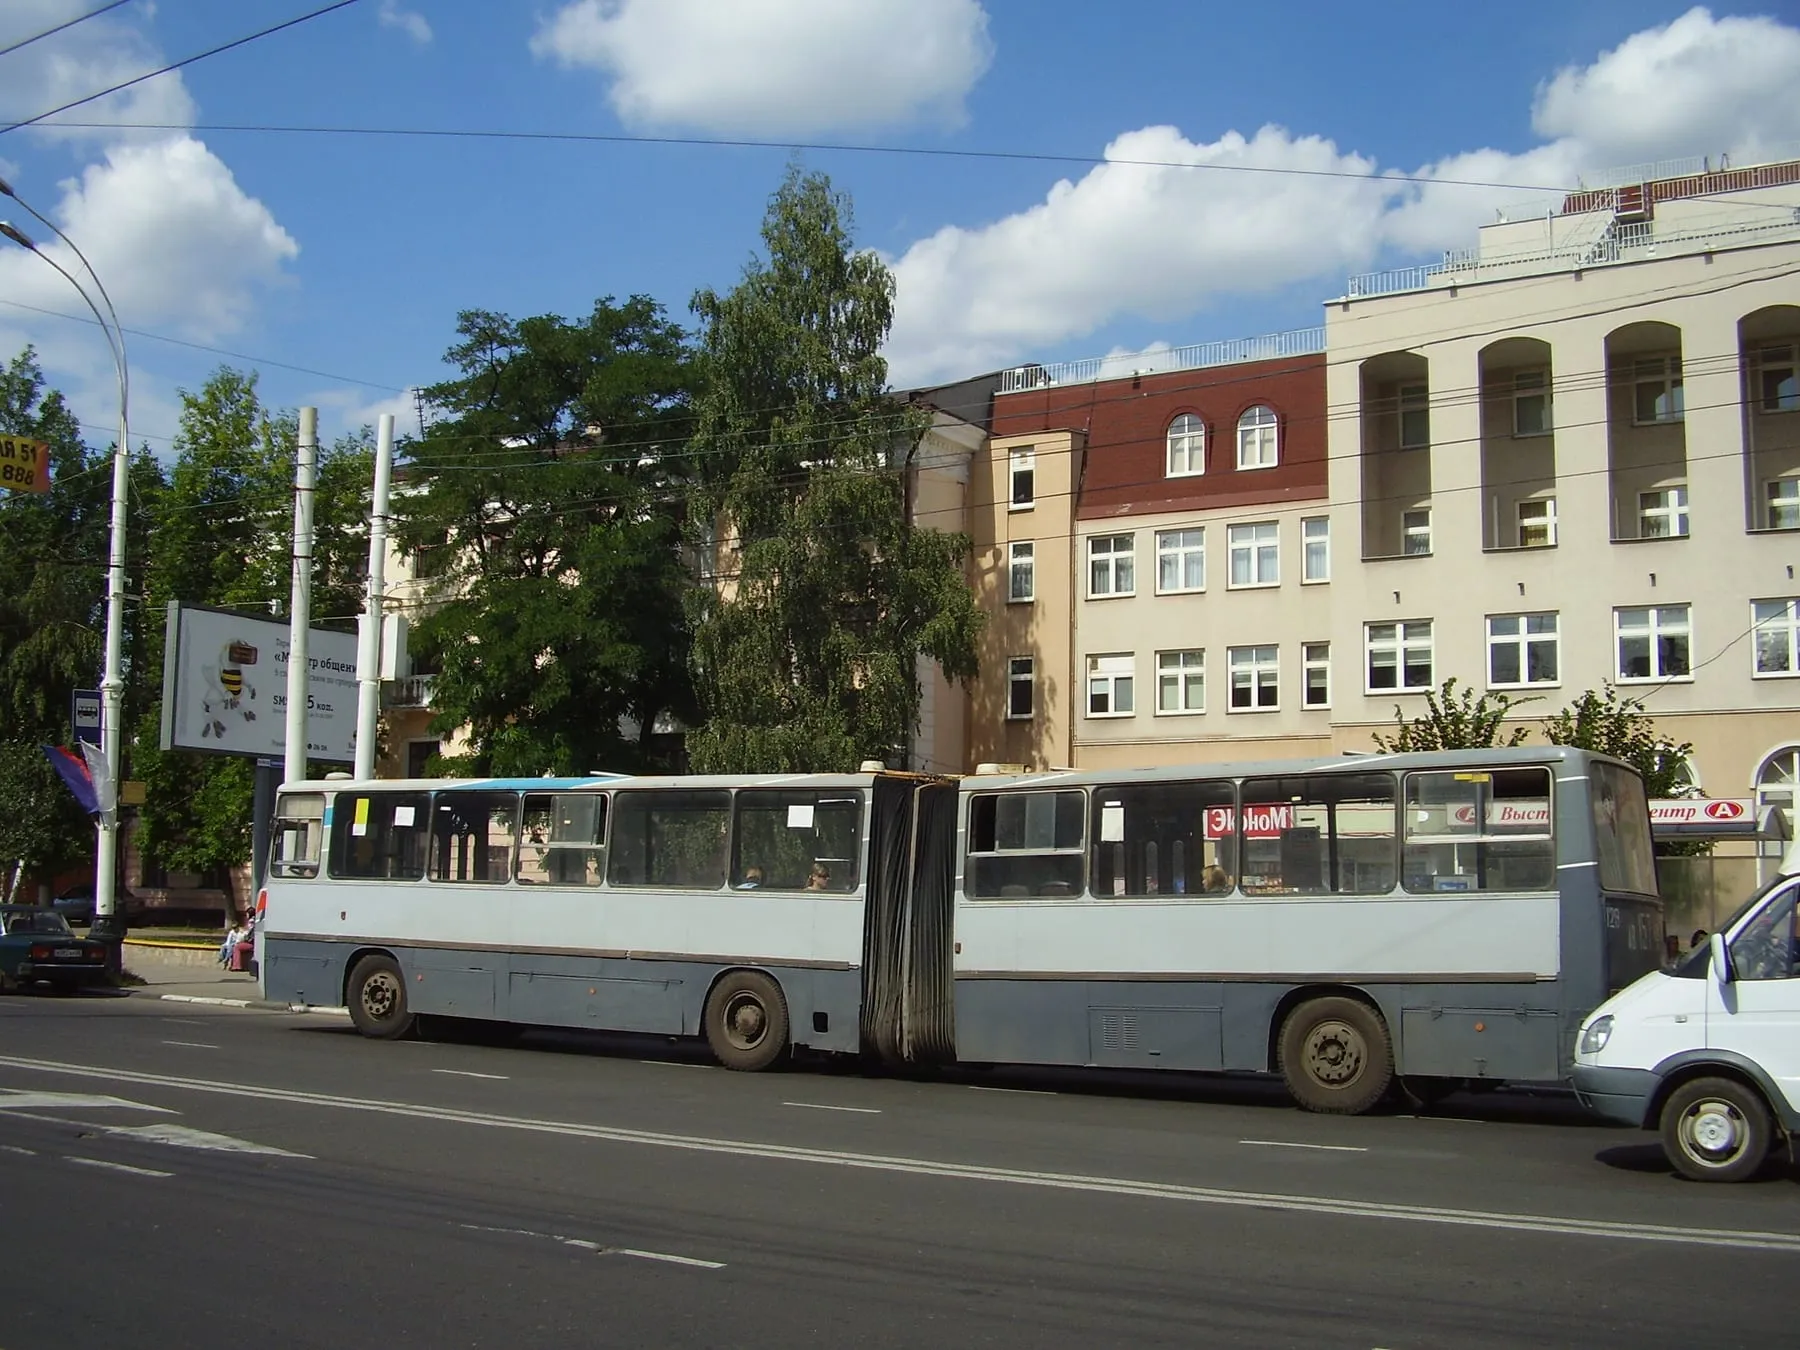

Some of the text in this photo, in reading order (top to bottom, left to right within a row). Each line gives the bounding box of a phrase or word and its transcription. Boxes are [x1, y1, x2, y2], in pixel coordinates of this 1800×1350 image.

[21, 444, 36, 463] 51
[3, 464, 34, 485] 888
[320, 657, 357, 673] общени
[1501, 806, 1549, 821] Выст
[1648, 806, 1697, 820] ентр
